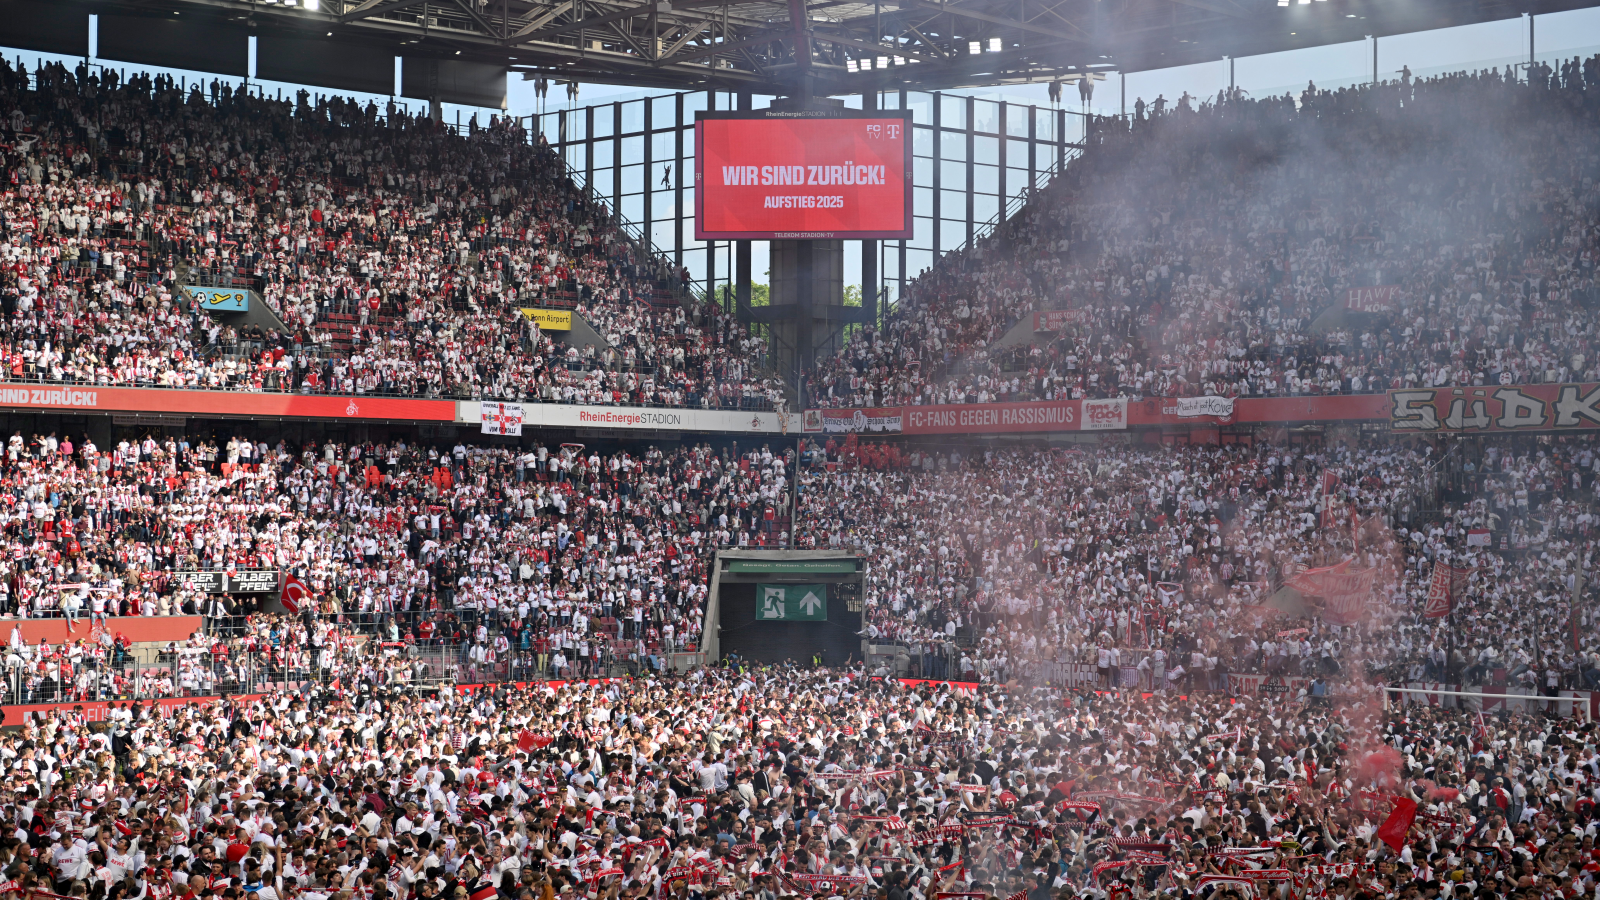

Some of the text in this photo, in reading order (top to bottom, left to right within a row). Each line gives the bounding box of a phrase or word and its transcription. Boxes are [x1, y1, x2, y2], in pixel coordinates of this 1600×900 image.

[866, 124, 881, 132] FC
[722, 160, 886, 186] WIR SIND ZURÜCK!
[764, 195, 844, 209] AUFSTIEG 2025
[547, 315, 570, 324] Airport
[0, 387, 98, 406] IND ZURÜCK!
[579, 410, 681, 425] RheinEnergieSTADION
[909, 406, 1074, 427] FC-FANS GEGEN RASSISMUS
[232, 573, 273, 582] SILBER
[239, 582, 270, 591] PFEIL
